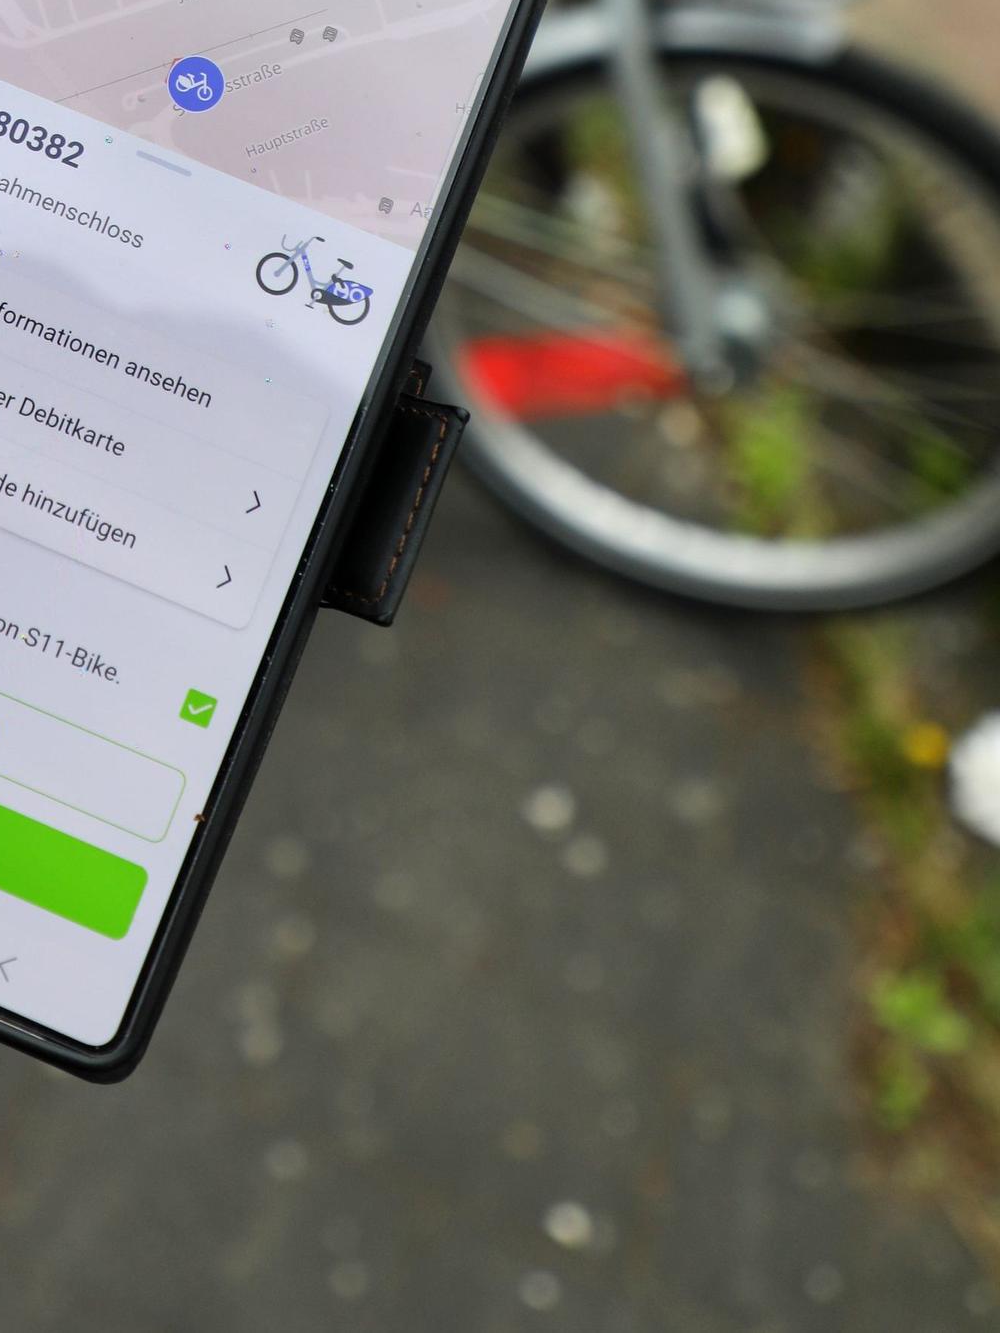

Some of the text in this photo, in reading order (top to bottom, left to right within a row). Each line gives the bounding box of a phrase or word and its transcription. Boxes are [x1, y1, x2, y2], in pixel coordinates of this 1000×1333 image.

[245, 118, 329, 158] Hauptstraße
[124, 361, 213, 408] ansehen
[18, 397, 126, 457] Debitkarte
[21, 483, 137, 549] hinzufügen
[22, 627, 121, 685] S11-Bike.
